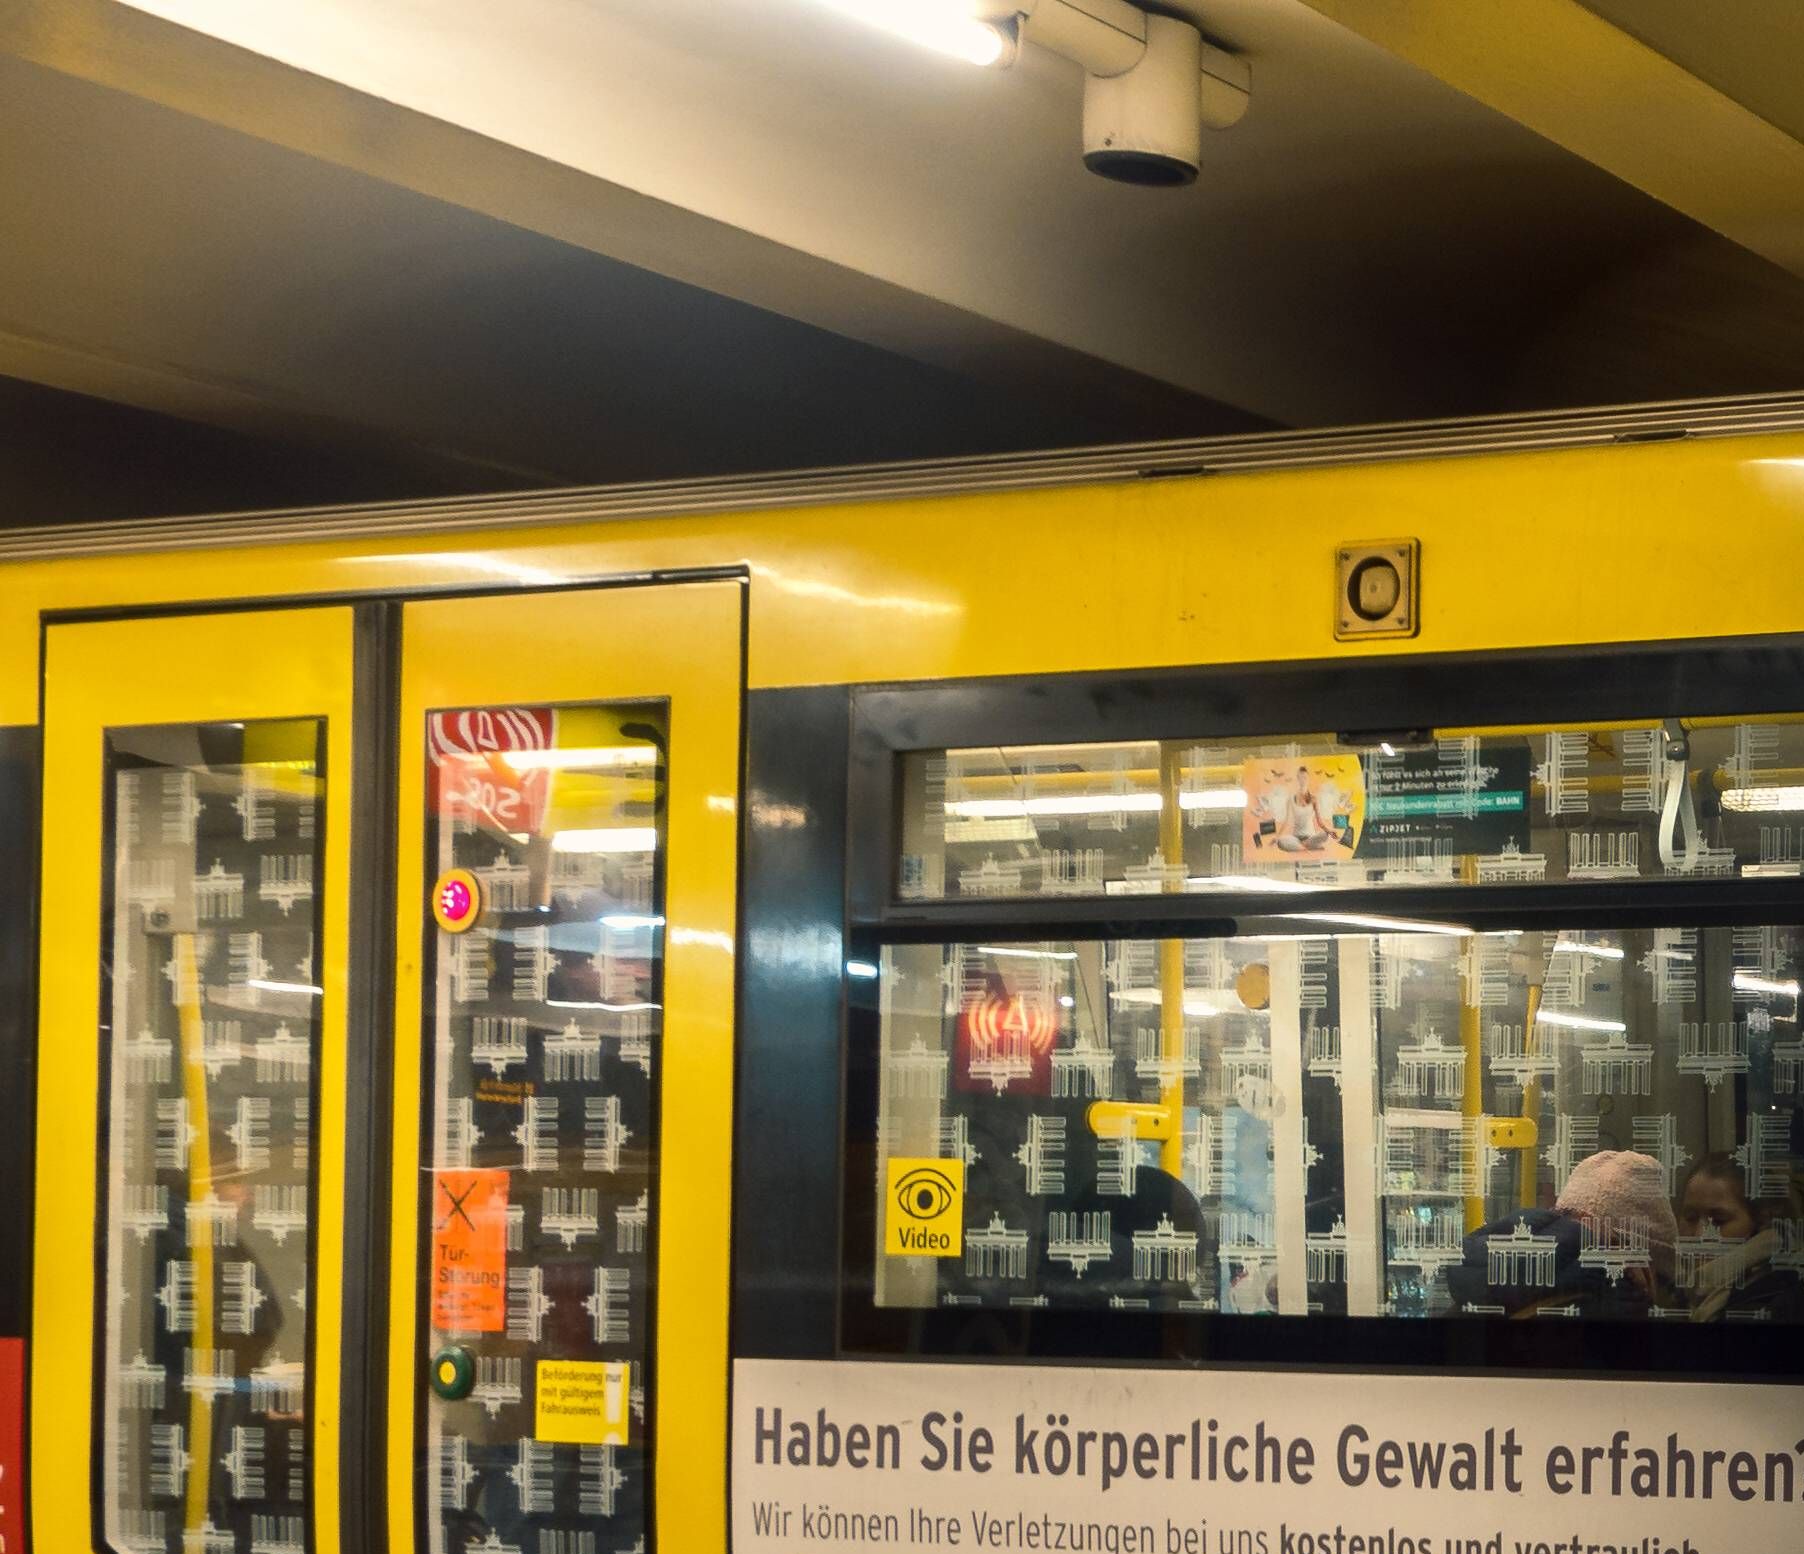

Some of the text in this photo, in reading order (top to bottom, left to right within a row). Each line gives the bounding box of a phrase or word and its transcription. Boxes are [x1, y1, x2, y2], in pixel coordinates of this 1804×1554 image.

[898, 1226, 950, 1250] Video
[755, 1407, 900, 1469] Haben
[920, 1411, 994, 1473] Sie
[1015, 1413, 1315, 1492] körperliche
[1337, 1424, 1522, 1493] Gewalt
[753, 1502, 792, 1536] Wir
[803, 1504, 898, 1541] können
[911, 1508, 961, 1545] Ihre
